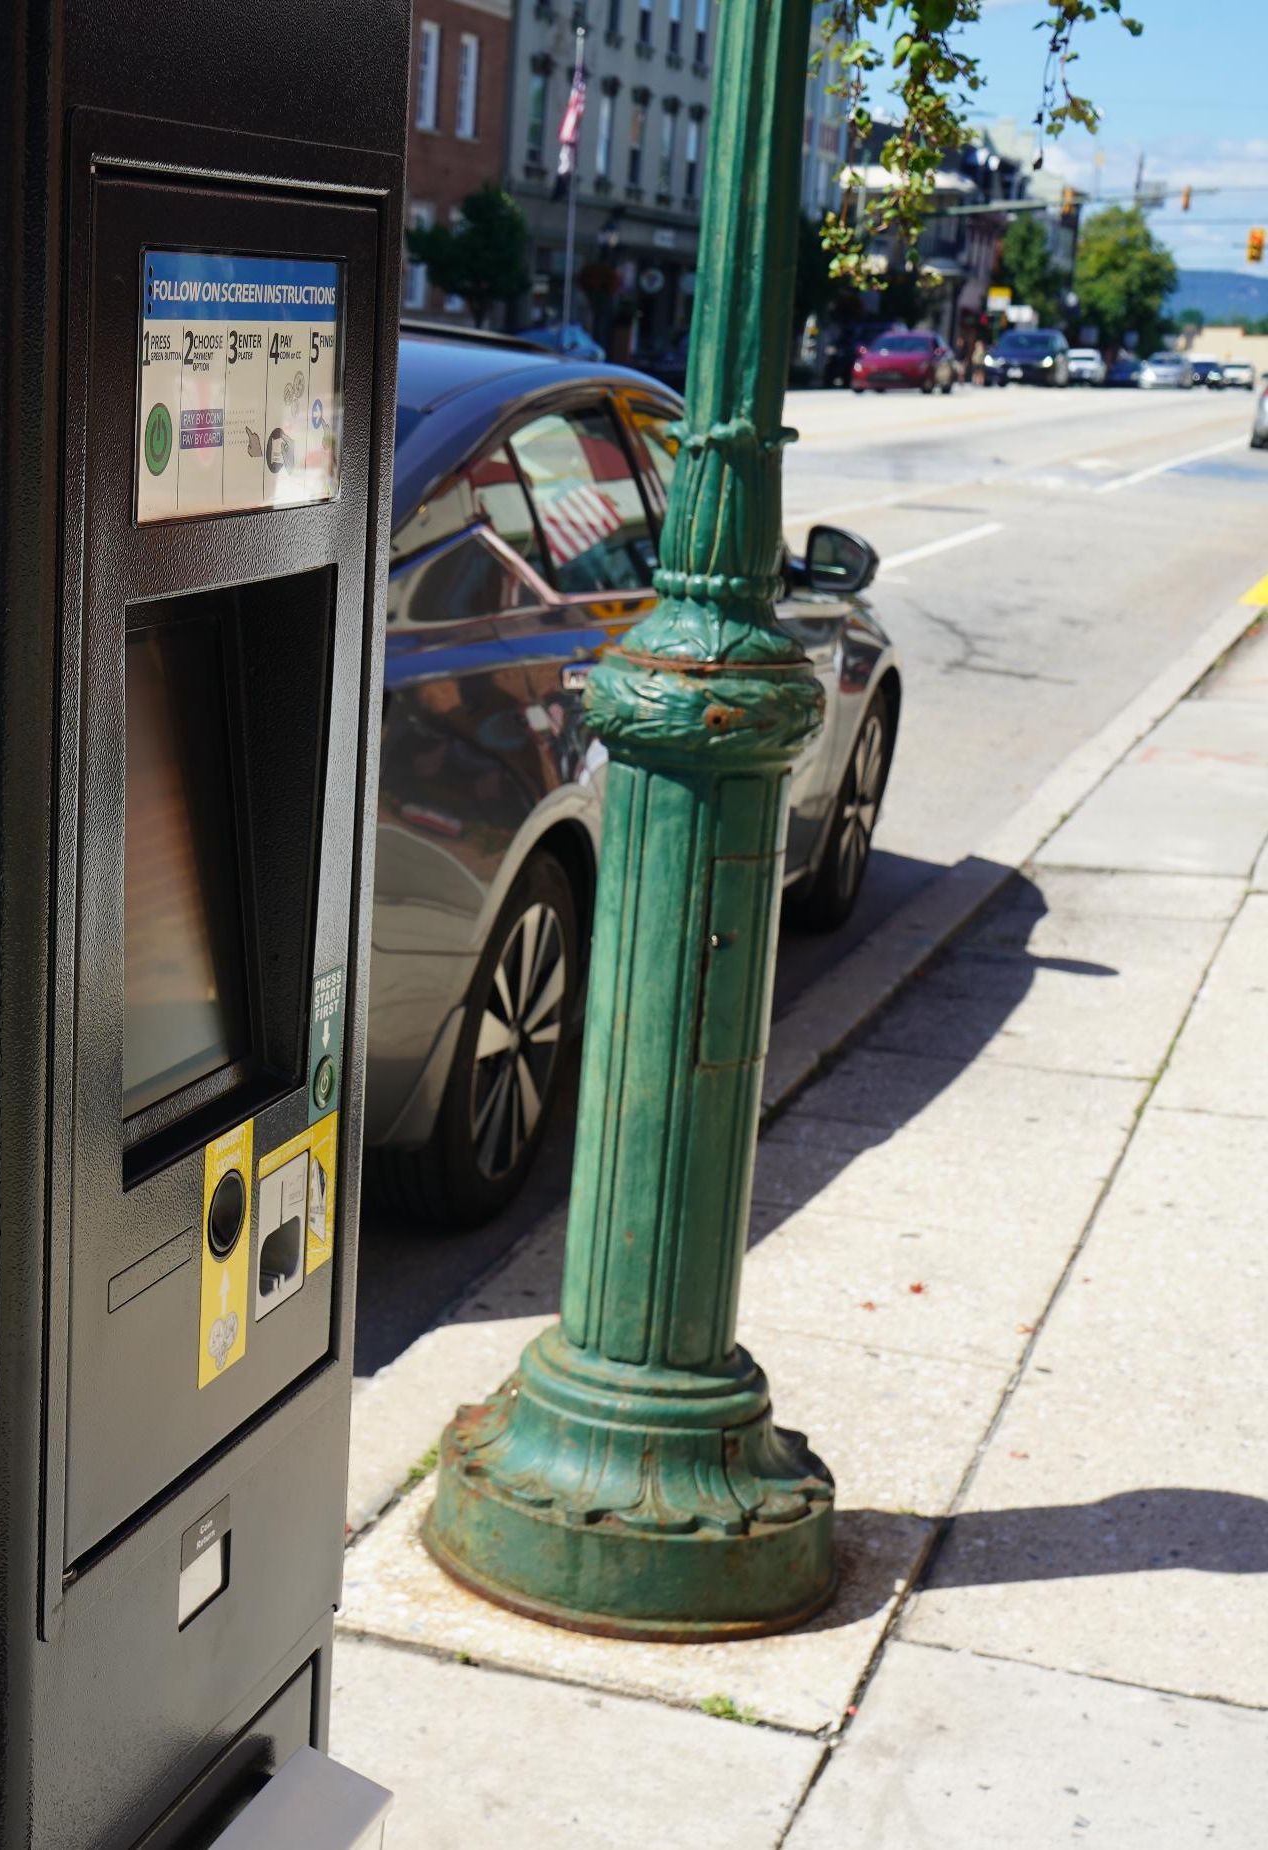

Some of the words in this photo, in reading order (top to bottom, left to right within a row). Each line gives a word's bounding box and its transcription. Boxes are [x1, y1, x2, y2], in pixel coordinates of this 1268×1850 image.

[153, 279, 199, 302] FOLLOW
[202, 281, 222, 302] ON
[222, 282, 262, 304] SCREEN
[264, 284, 335, 305] INSTRUCTIONS
[143, 330, 150, 366] 1
[151, 335, 171, 349] PRESS
[150, 351, 163, 361] GREEN
[164, 351, 181, 361] BUTTON
[184, 330, 194, 365] 2
[194, 335, 223, 349] CHOOSE
[193, 352, 213, 361] PAYMENT
[228, 330, 237, 364] 3
[239, 334, 262, 349] ENTER
[269, 333, 279, 365] 4
[281, 335, 293, 348] PAY
[311, 332, 319, 363] 5
[193, 363, 210, 371] OPTION
[183, 413, 195, 426] PAY
[196, 413, 205, 425] BY
[182, 434, 195, 446] PAY
[195, 433, 203, 445] BY
[204, 432, 221, 445] CARD
[315, 970, 342, 993] PRESS
[314, 985, 342, 1008] START
[314, 999, 340, 1023] FIRST
[199, 1520, 213, 1534] Coin
[196, 1530, 216, 1550] Return
